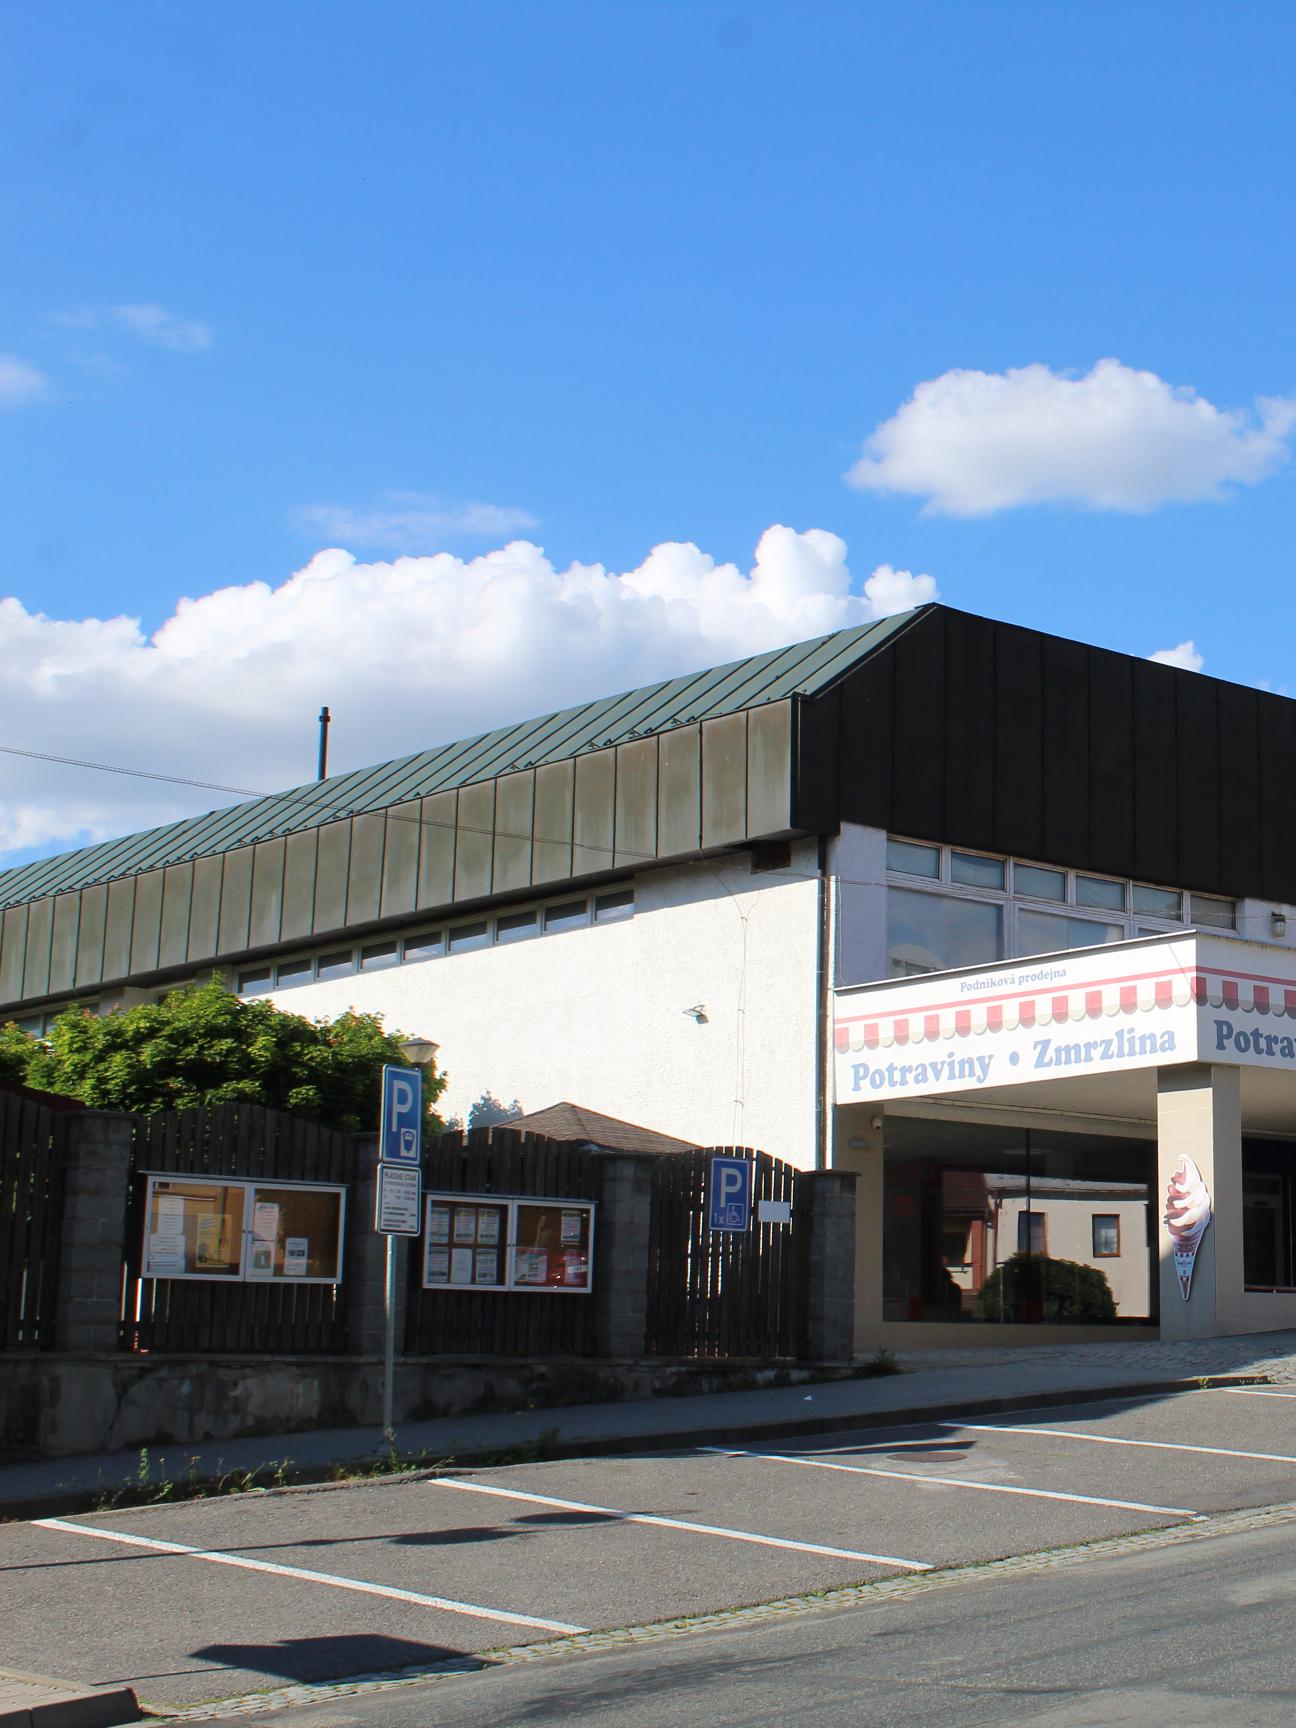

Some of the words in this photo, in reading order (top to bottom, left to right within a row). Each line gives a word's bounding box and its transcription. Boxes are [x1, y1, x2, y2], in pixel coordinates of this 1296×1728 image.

[960, 974, 1016, 992] Podniková
[1018, 967, 1067, 985] prodejna
[851, 1052, 994, 1092] Potraviny
[1033, 1027, 1177, 1069] Zmrzlina
[392, 1080, 413, 1132] P
[719, 1167, 743, 1208] P
[713, 1213, 724, 1225] 1x
